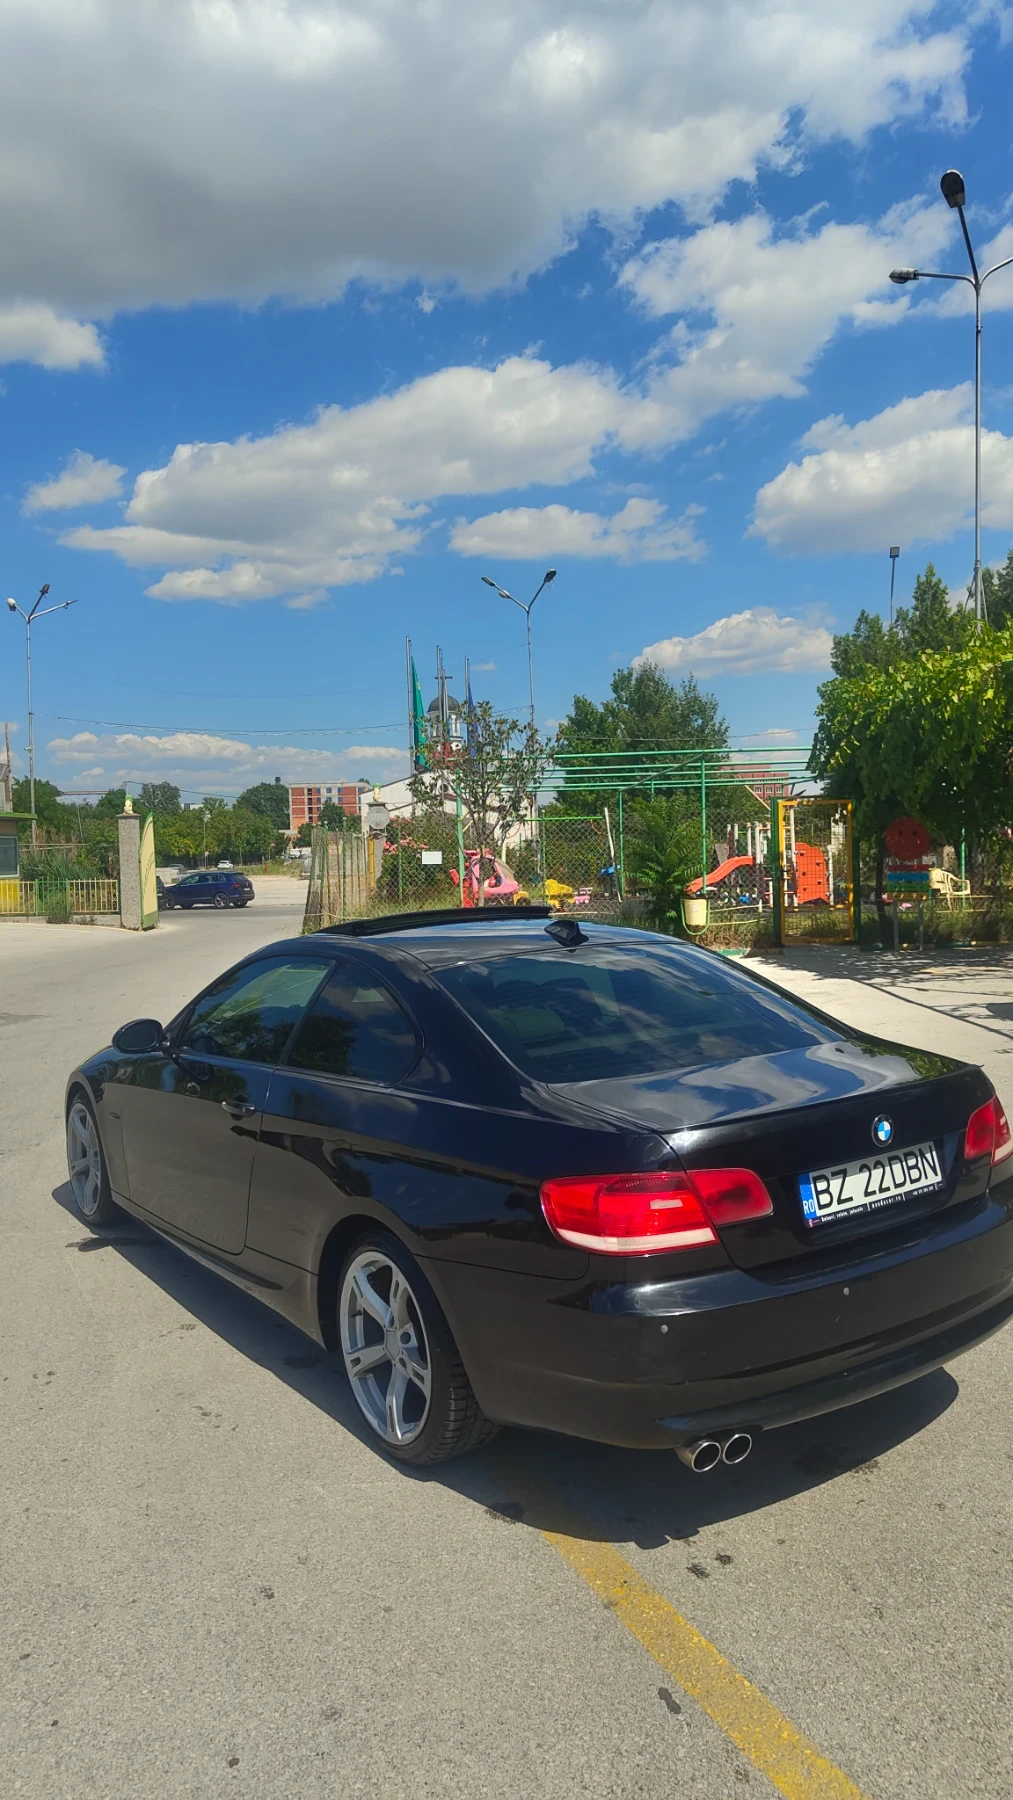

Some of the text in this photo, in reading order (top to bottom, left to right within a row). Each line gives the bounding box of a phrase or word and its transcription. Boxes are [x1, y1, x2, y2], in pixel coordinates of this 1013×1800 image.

[813, 1145, 938, 1211] BZ 22DBN
[803, 1199, 814, 1215] RO
